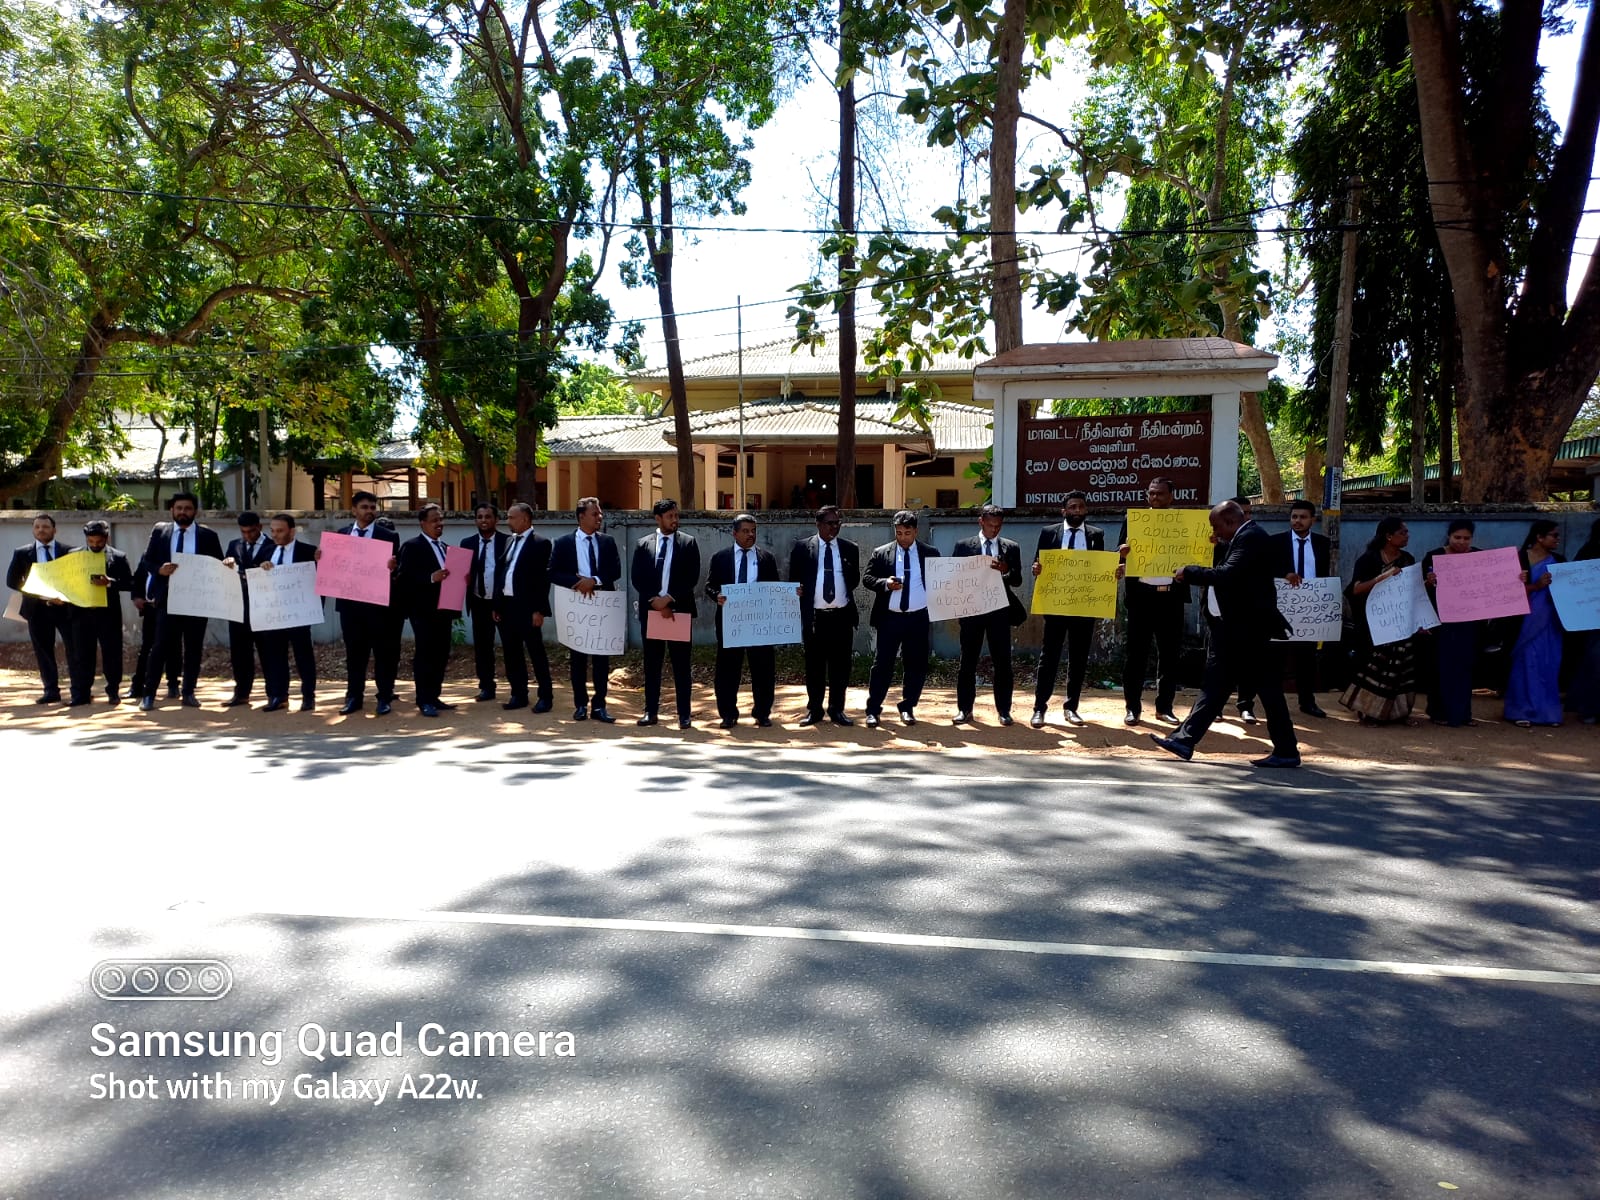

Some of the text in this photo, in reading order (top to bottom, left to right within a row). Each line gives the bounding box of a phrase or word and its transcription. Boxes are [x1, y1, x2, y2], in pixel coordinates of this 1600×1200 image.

[1089, 440, 1138, 454] வவுனியா.
[1172, 488, 1198, 501] URT.
[1130, 511, 1184, 524] Do not
[1144, 524, 1190, 539] abuse
[932, 576, 980, 594] are you
[569, 591, 621, 608] Justice
[728, 598, 763, 609] racism
[936, 593, 976, 606] above
[1378, 610, 1406, 627] with
[566, 624, 625, 652] Politics
[731, 624, 743, 638] of
